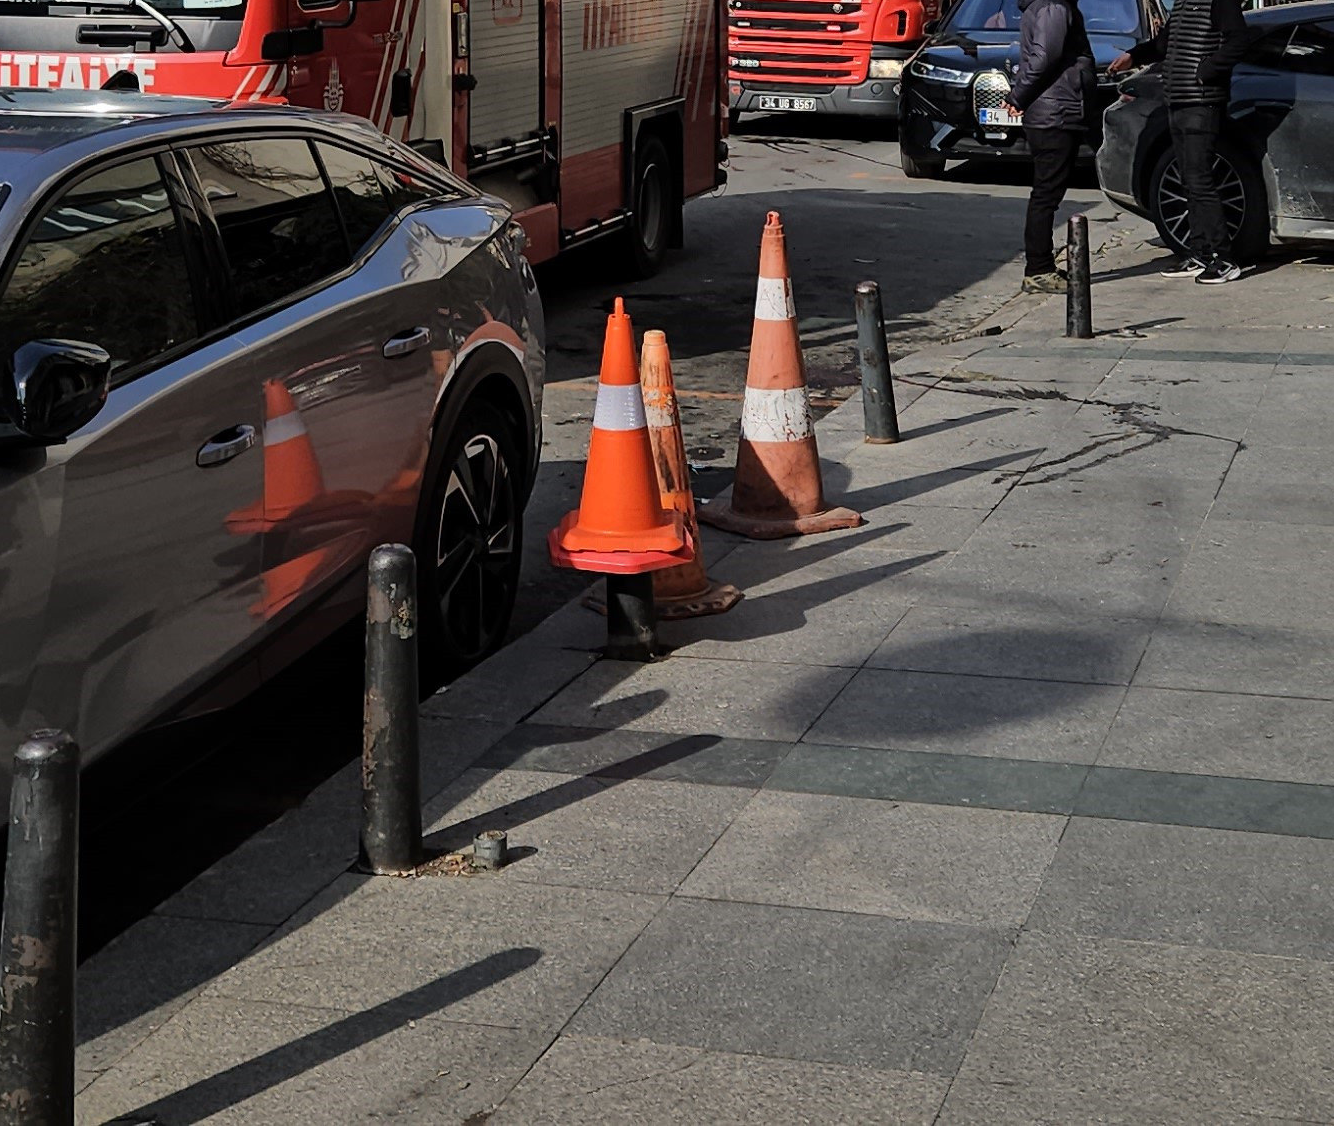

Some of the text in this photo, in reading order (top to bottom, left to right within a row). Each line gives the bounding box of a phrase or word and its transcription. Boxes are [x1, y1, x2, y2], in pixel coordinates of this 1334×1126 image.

[0, 53, 156, 93] İTFAİYE
[765, 97, 814, 110] 34 UG 8567
[987, 111, 999, 123] 34
